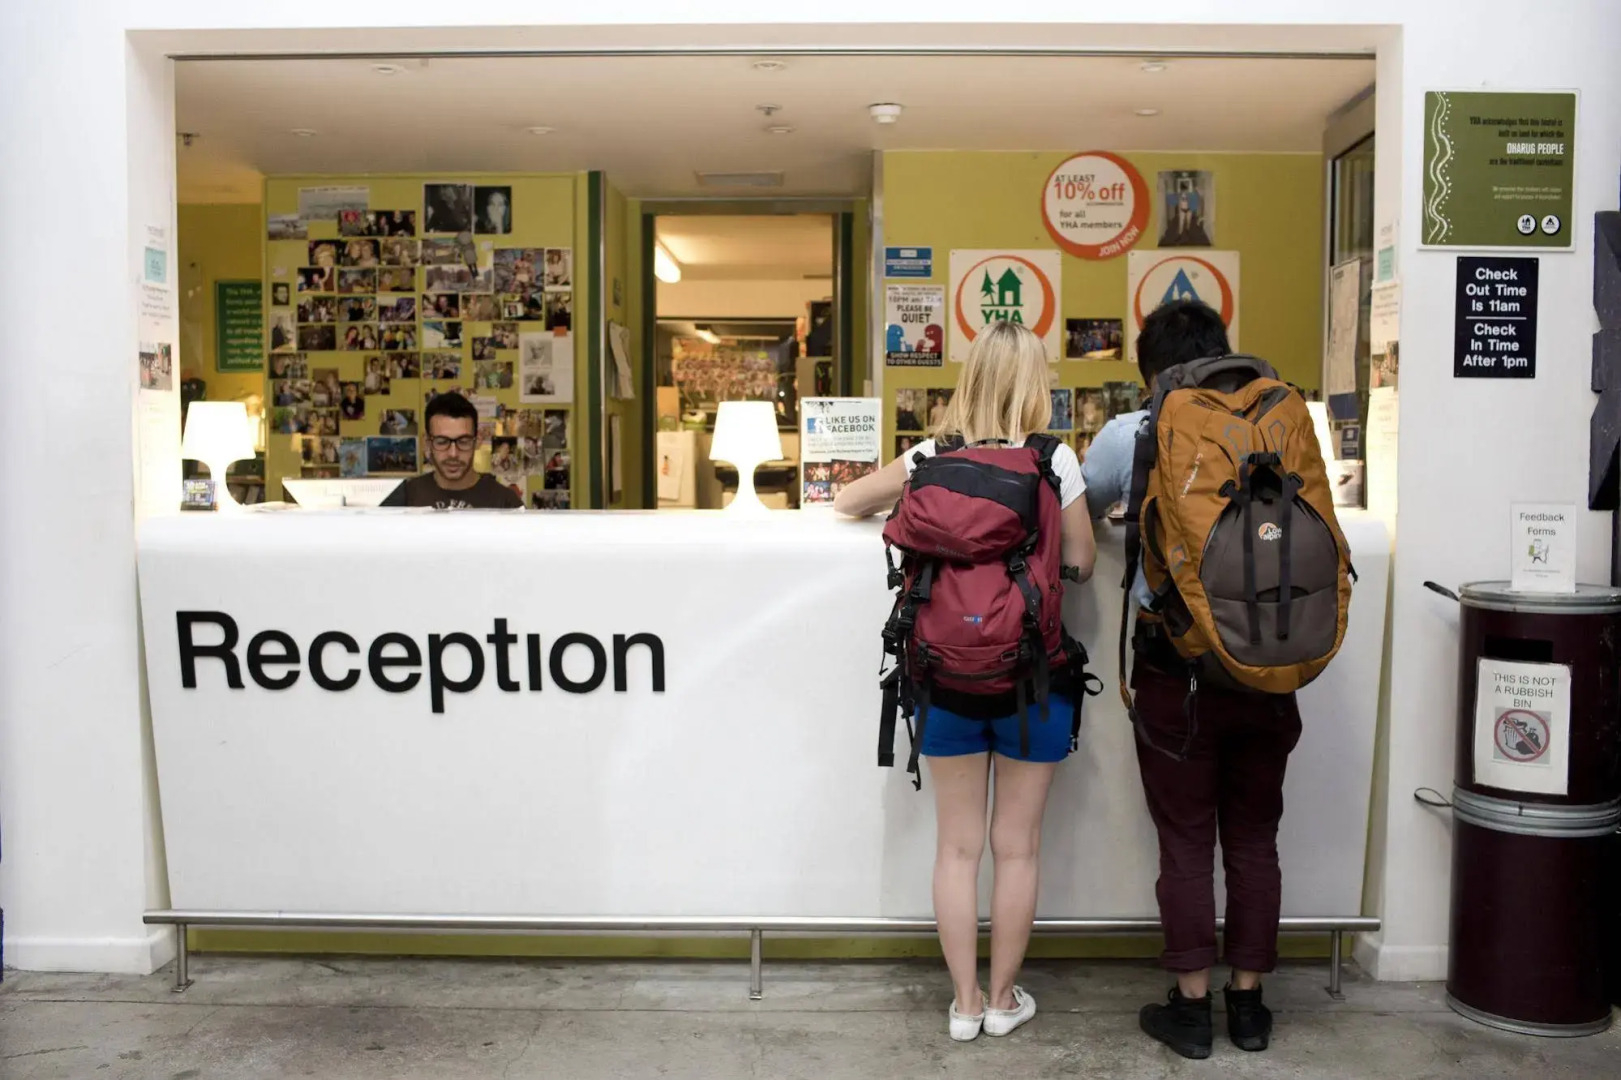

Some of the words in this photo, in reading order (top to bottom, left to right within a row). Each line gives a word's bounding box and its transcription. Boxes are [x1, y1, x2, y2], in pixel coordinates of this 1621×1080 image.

[1537, 143, 1564, 155] PEOPLE
[1055, 174, 1065, 182] AT
[1068, 174, 1095, 182] LEAST
[1054, 181, 1095, 200] 10%
[1099, 183, 1125, 201] off
[1059, 210, 1072, 218] for
[1074, 210, 1086, 218] all
[1060, 221, 1079, 229] YHA
[1080, 221, 1123, 229] members
[1099, 241, 1121, 257] JOIN
[1119, 225, 1140, 248] NOW
[1475, 267, 1518, 280] Check
[1465, 283, 1490, 296] Out
[1495, 283, 1527, 297] Time
[896, 304, 922, 312] PLEASE
[1471, 299, 1484, 312] Is
[1489, 299, 1520, 312] 11am
[901, 313, 932, 324] QUIET
[980, 309, 1024, 325] YHA
[1474, 323, 1517, 336] Check
[1470, 338, 1483, 351] In
[1487, 338, 1520, 352] Time
[895, 358, 917, 366] OTHER
[917, 358, 941, 366] GUESTS
[1463, 354, 1497, 367] After
[1501, 355, 1528, 370] 1pm
[826, 416, 847, 425] LIKE
[848, 415, 860, 424] US
[862, 415, 876, 423] ON
[1520, 513, 1565, 522] Feedback
[1527, 527, 1556, 536] Forms
[175, 610, 666, 714] Reception
[1493, 672, 1516, 684] THIS
[1519, 676, 1530, 685] IS
[1532, 677, 1557, 687] NOT
[1494, 685, 1502, 694] A
[1504, 686, 1553, 698] RUBBISH
[1513, 698, 1532, 708] BIN
